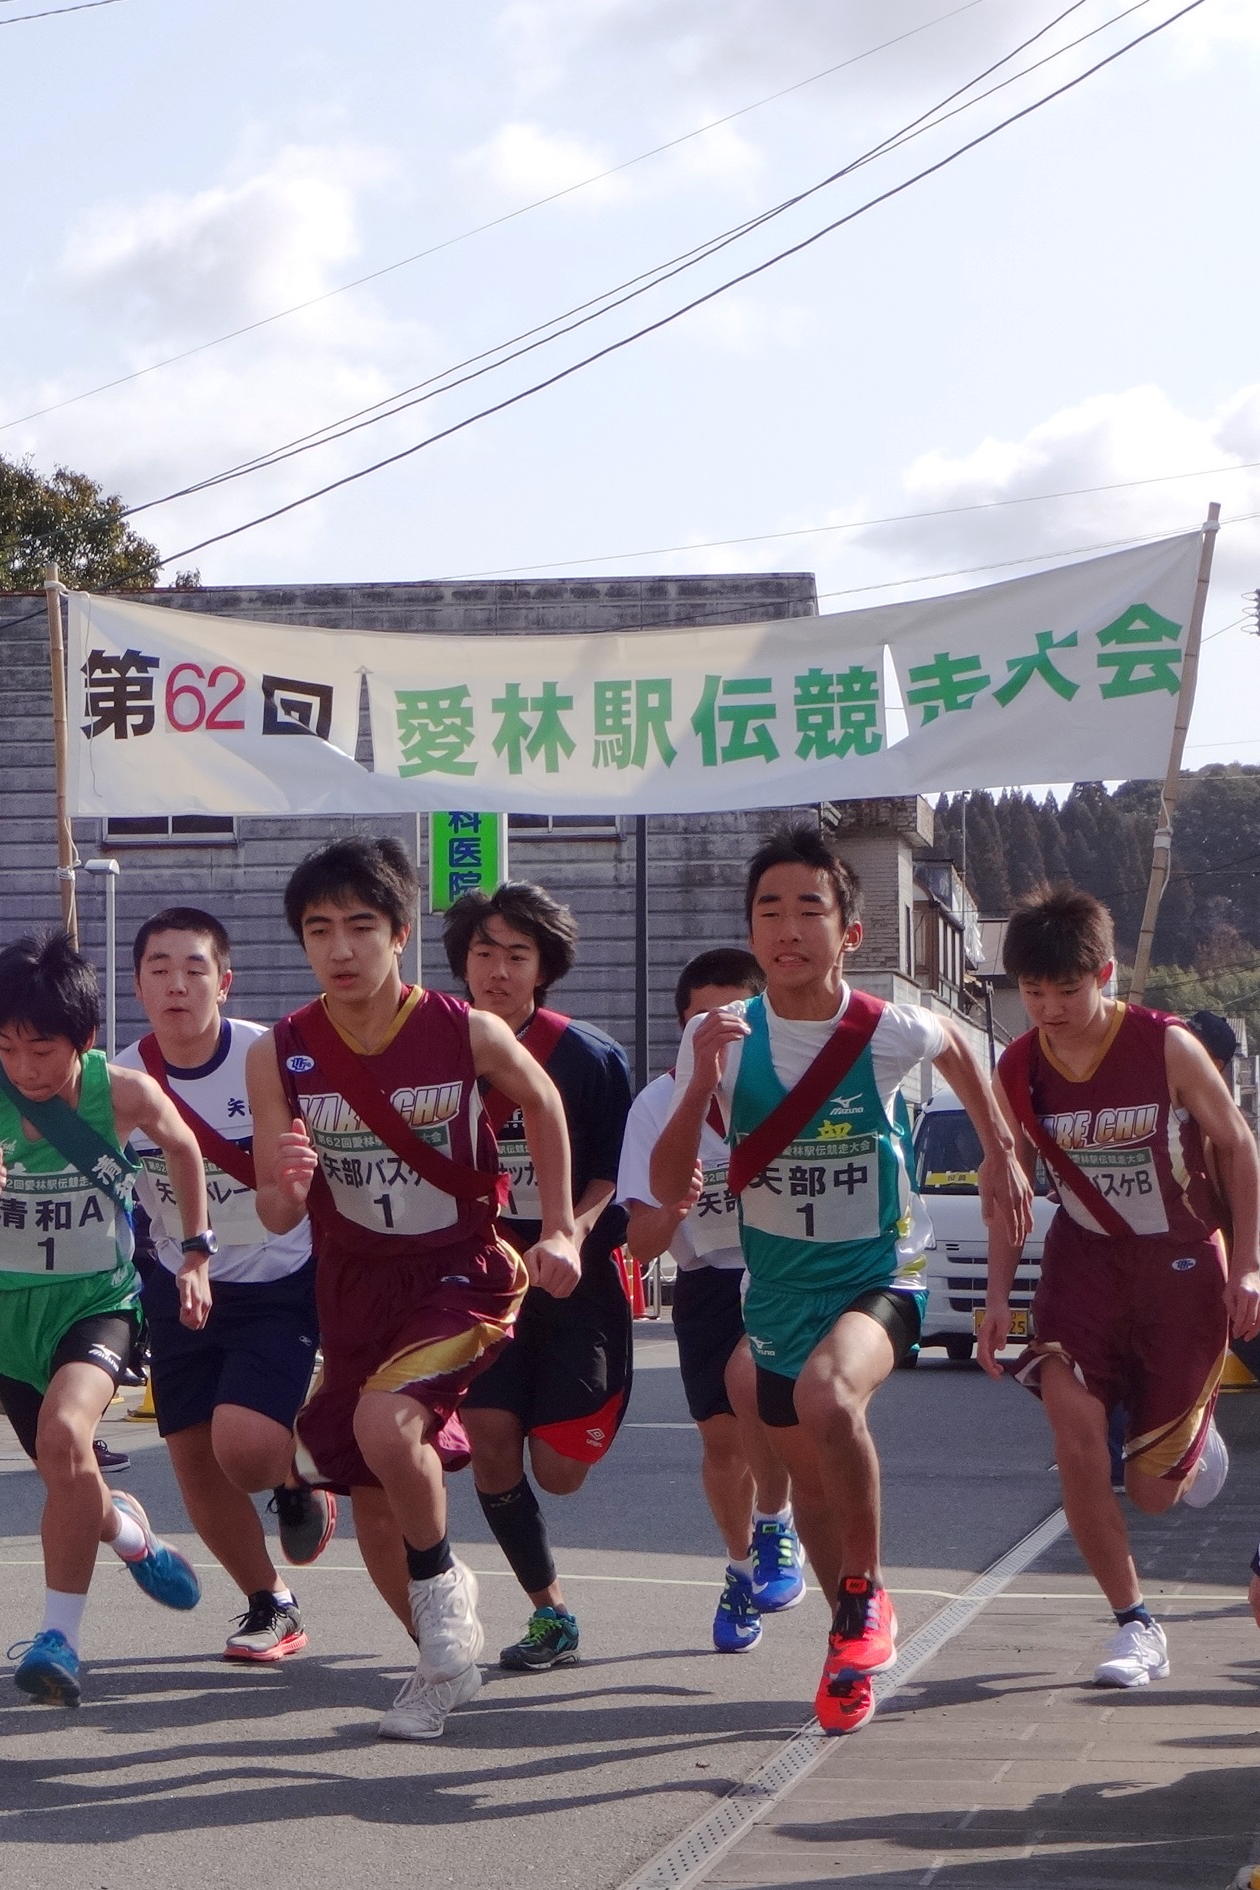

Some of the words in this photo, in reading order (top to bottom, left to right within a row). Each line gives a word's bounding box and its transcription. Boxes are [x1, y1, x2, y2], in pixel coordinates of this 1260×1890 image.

[1094, 1104, 1158, 1146] CHU
[374, 1194, 394, 1228] 1
[796, 1203, 814, 1237] 1
[37, 1237, 55, 1270] 1
